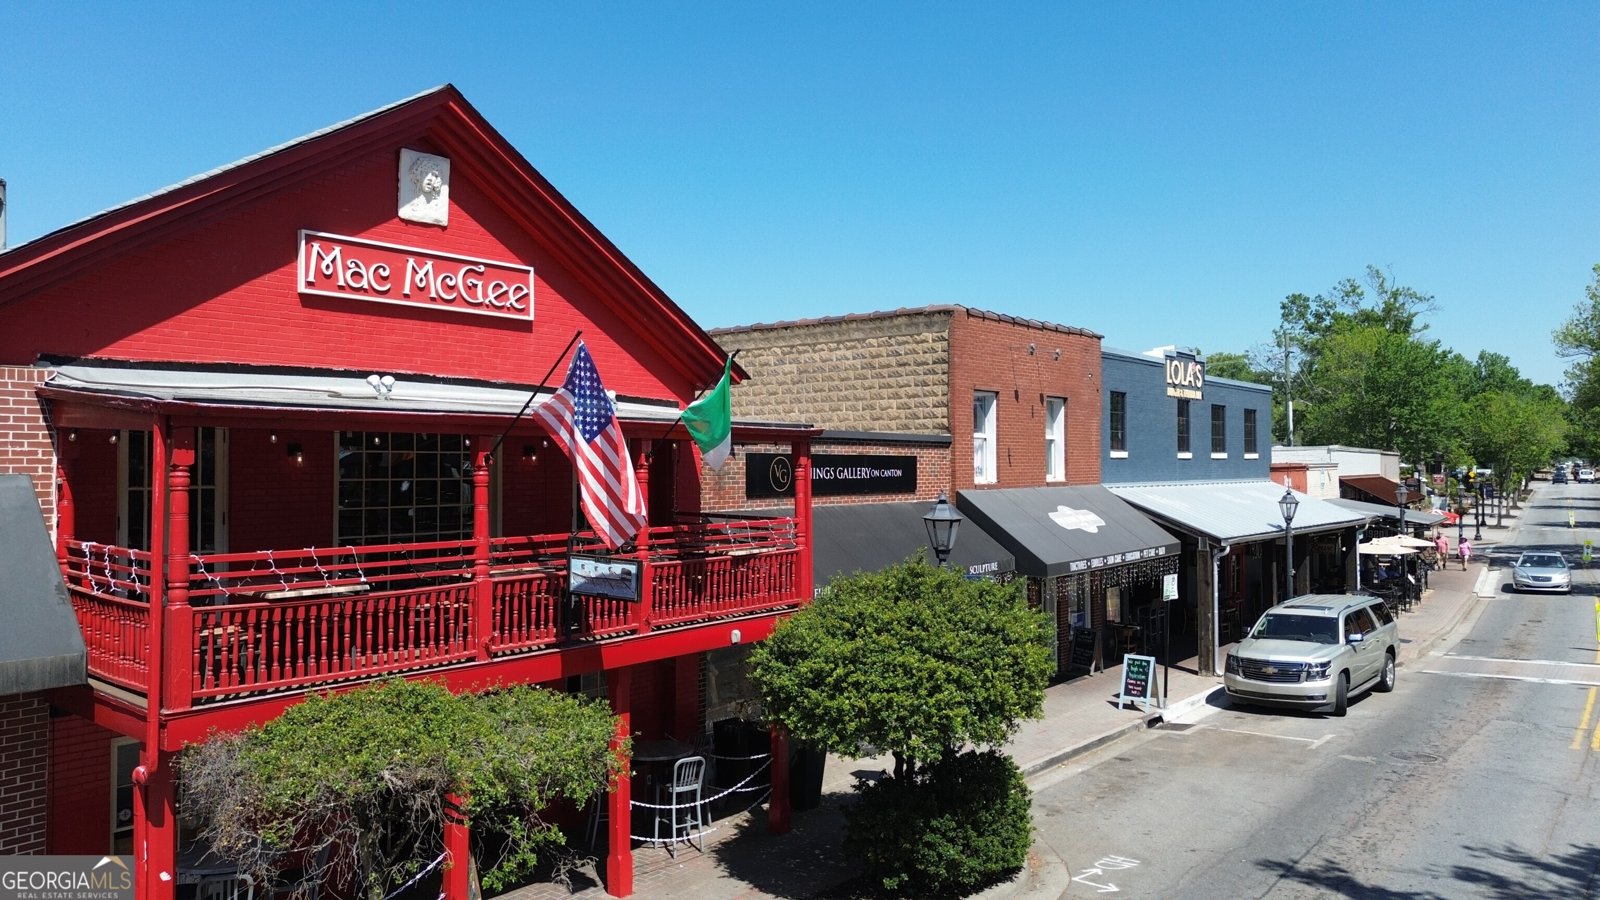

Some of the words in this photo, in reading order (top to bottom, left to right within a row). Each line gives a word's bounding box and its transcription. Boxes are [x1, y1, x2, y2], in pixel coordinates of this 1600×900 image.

[306, 242, 391, 291] Mac
[402, 257, 529, 310] McGee
[774, 464, 787, 483] VG
[810, 467, 834, 480] INGS
[836, 467, 871, 480] GALLERY
[871, 468, 880, 477] ON
[880, 468, 902, 477] CANTON
[969, 561, 999, 575] SCULPTURE
